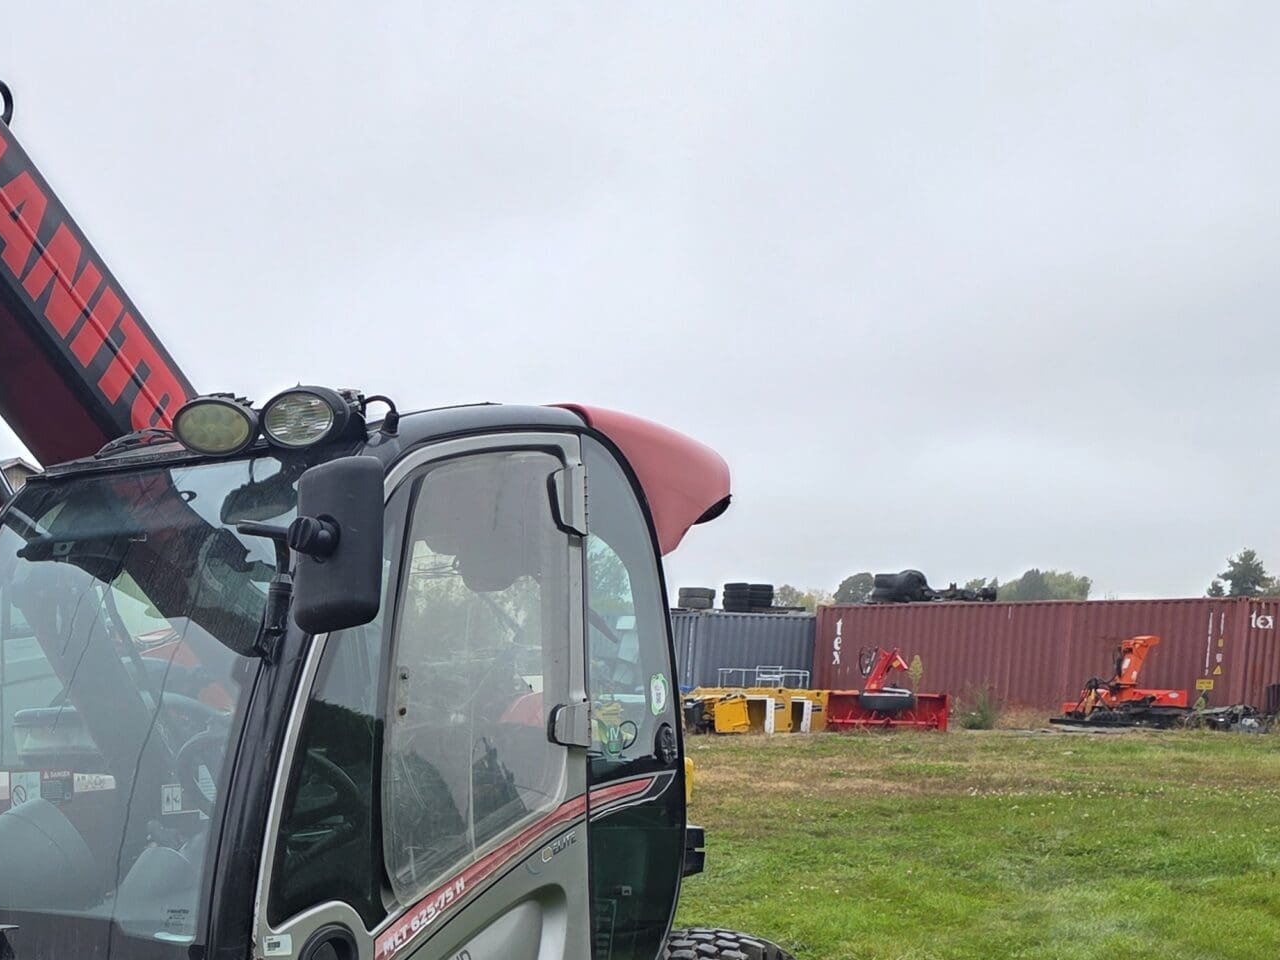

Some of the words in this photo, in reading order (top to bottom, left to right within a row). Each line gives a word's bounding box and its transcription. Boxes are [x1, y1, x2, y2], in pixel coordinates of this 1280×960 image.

[831, 618, 843, 665] tex
[382, 924, 410, 956] MLT
[455, 877, 465, 895] H
